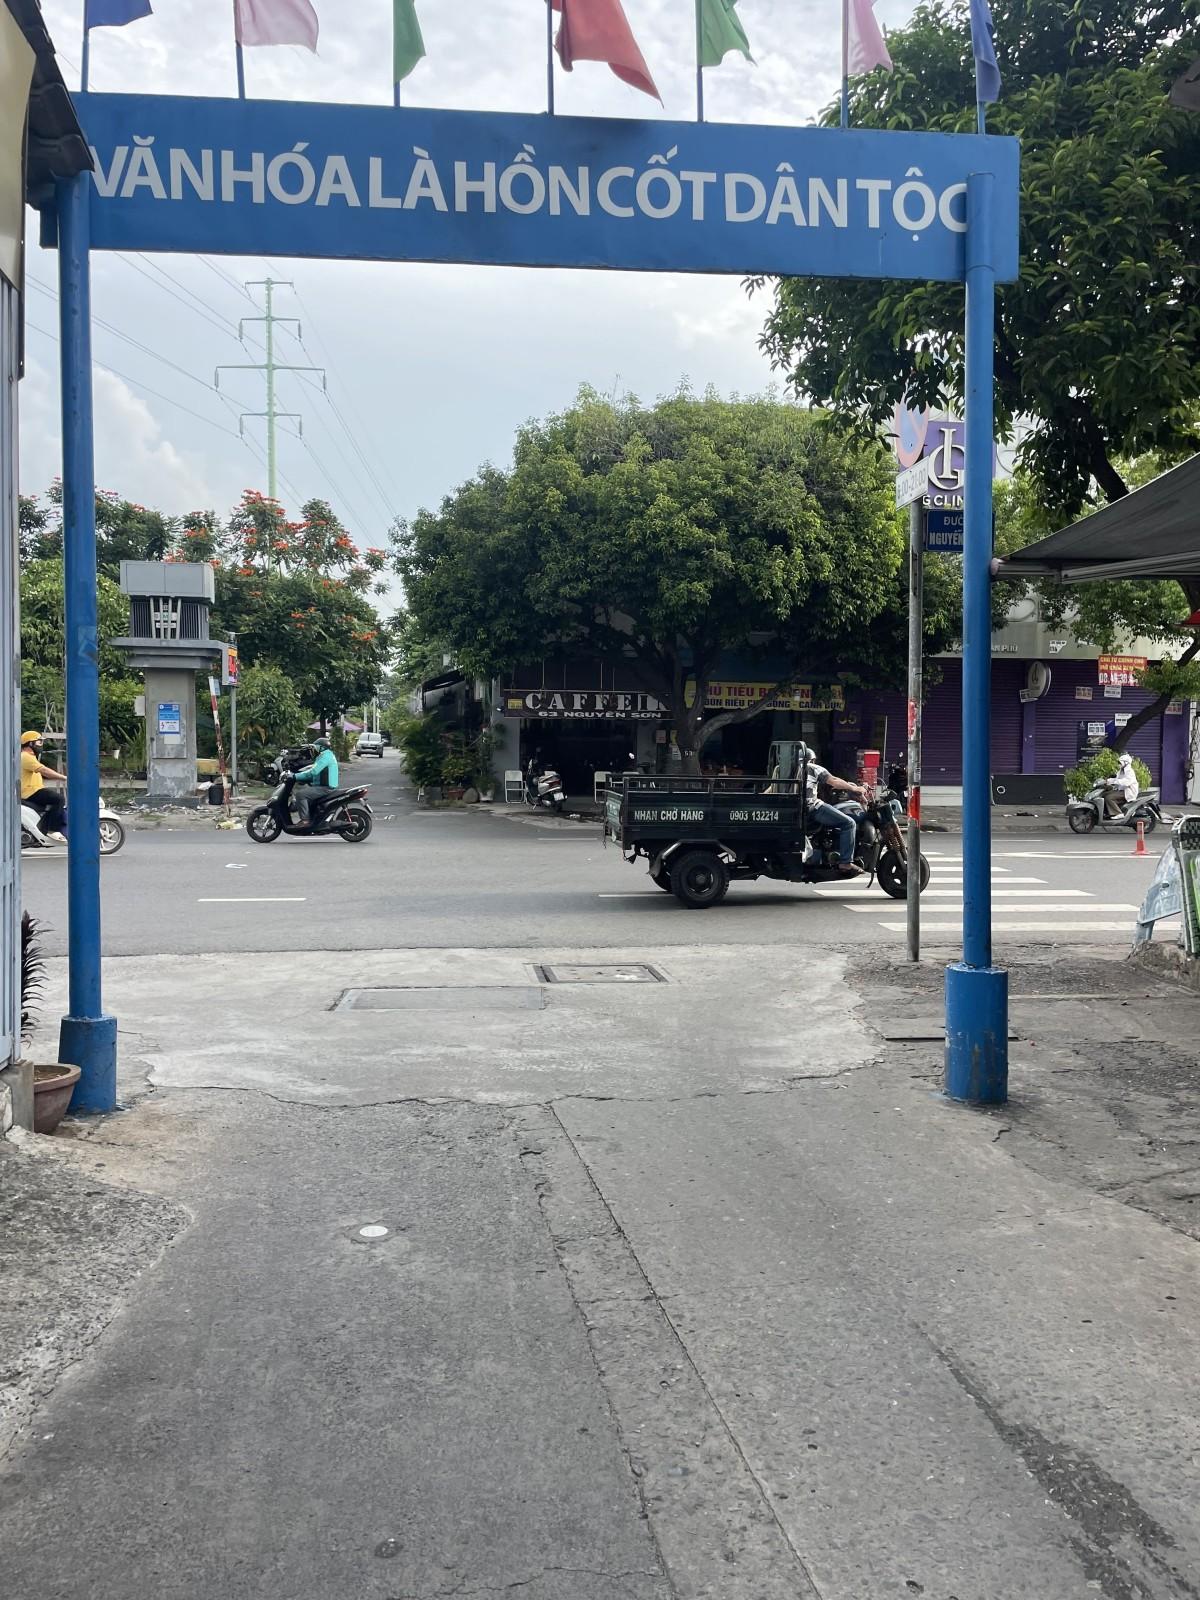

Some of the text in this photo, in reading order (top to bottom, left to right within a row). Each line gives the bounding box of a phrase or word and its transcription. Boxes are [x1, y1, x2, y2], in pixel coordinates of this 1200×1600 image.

[89, 134, 968, 242] VĂN HÓA LÀ HỒN CỐT DÂN TỘC
[729, 810, 779, 821] 0903 132214
